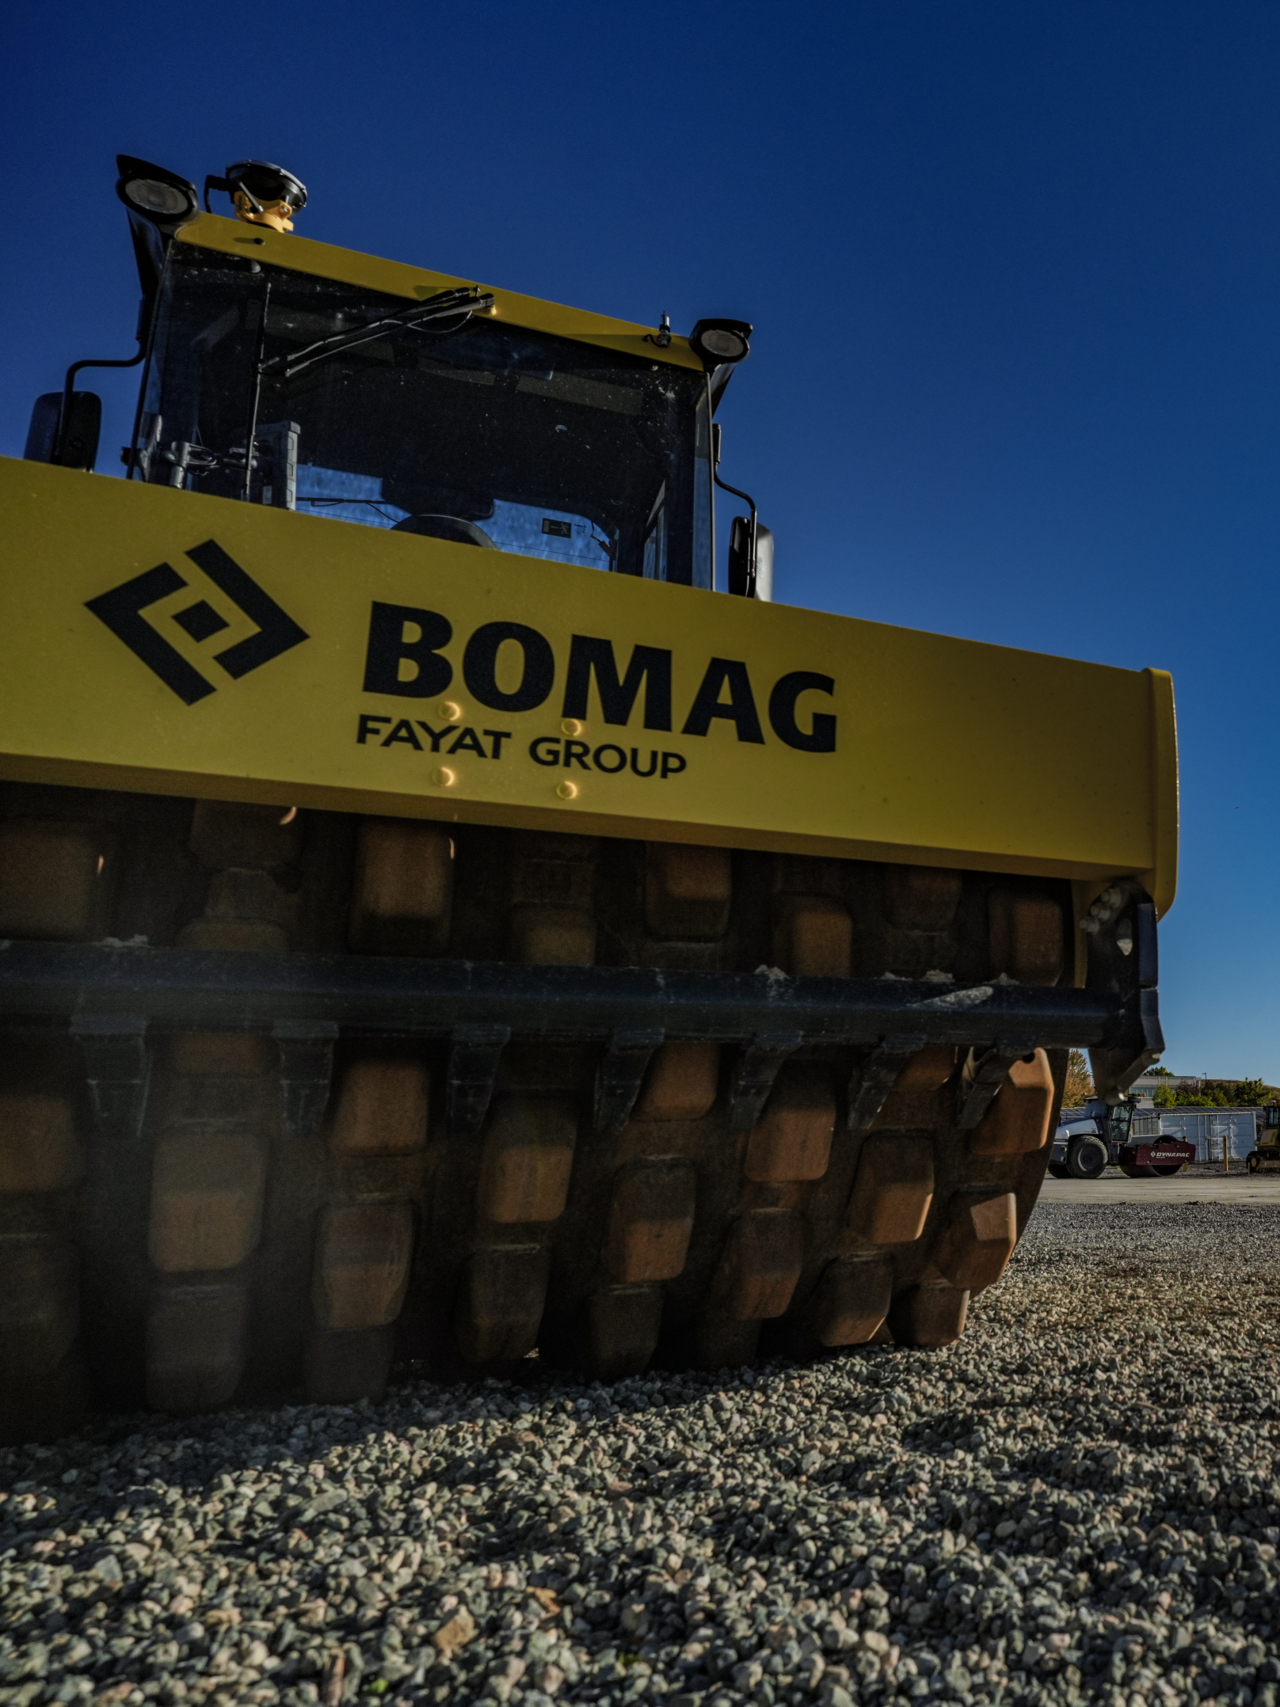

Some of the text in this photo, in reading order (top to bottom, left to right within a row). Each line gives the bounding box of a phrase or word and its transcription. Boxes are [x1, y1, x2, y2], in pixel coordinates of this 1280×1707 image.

[362, 600, 838, 754] BOMAG
[356, 713, 688, 779] FAYAT GROUP
